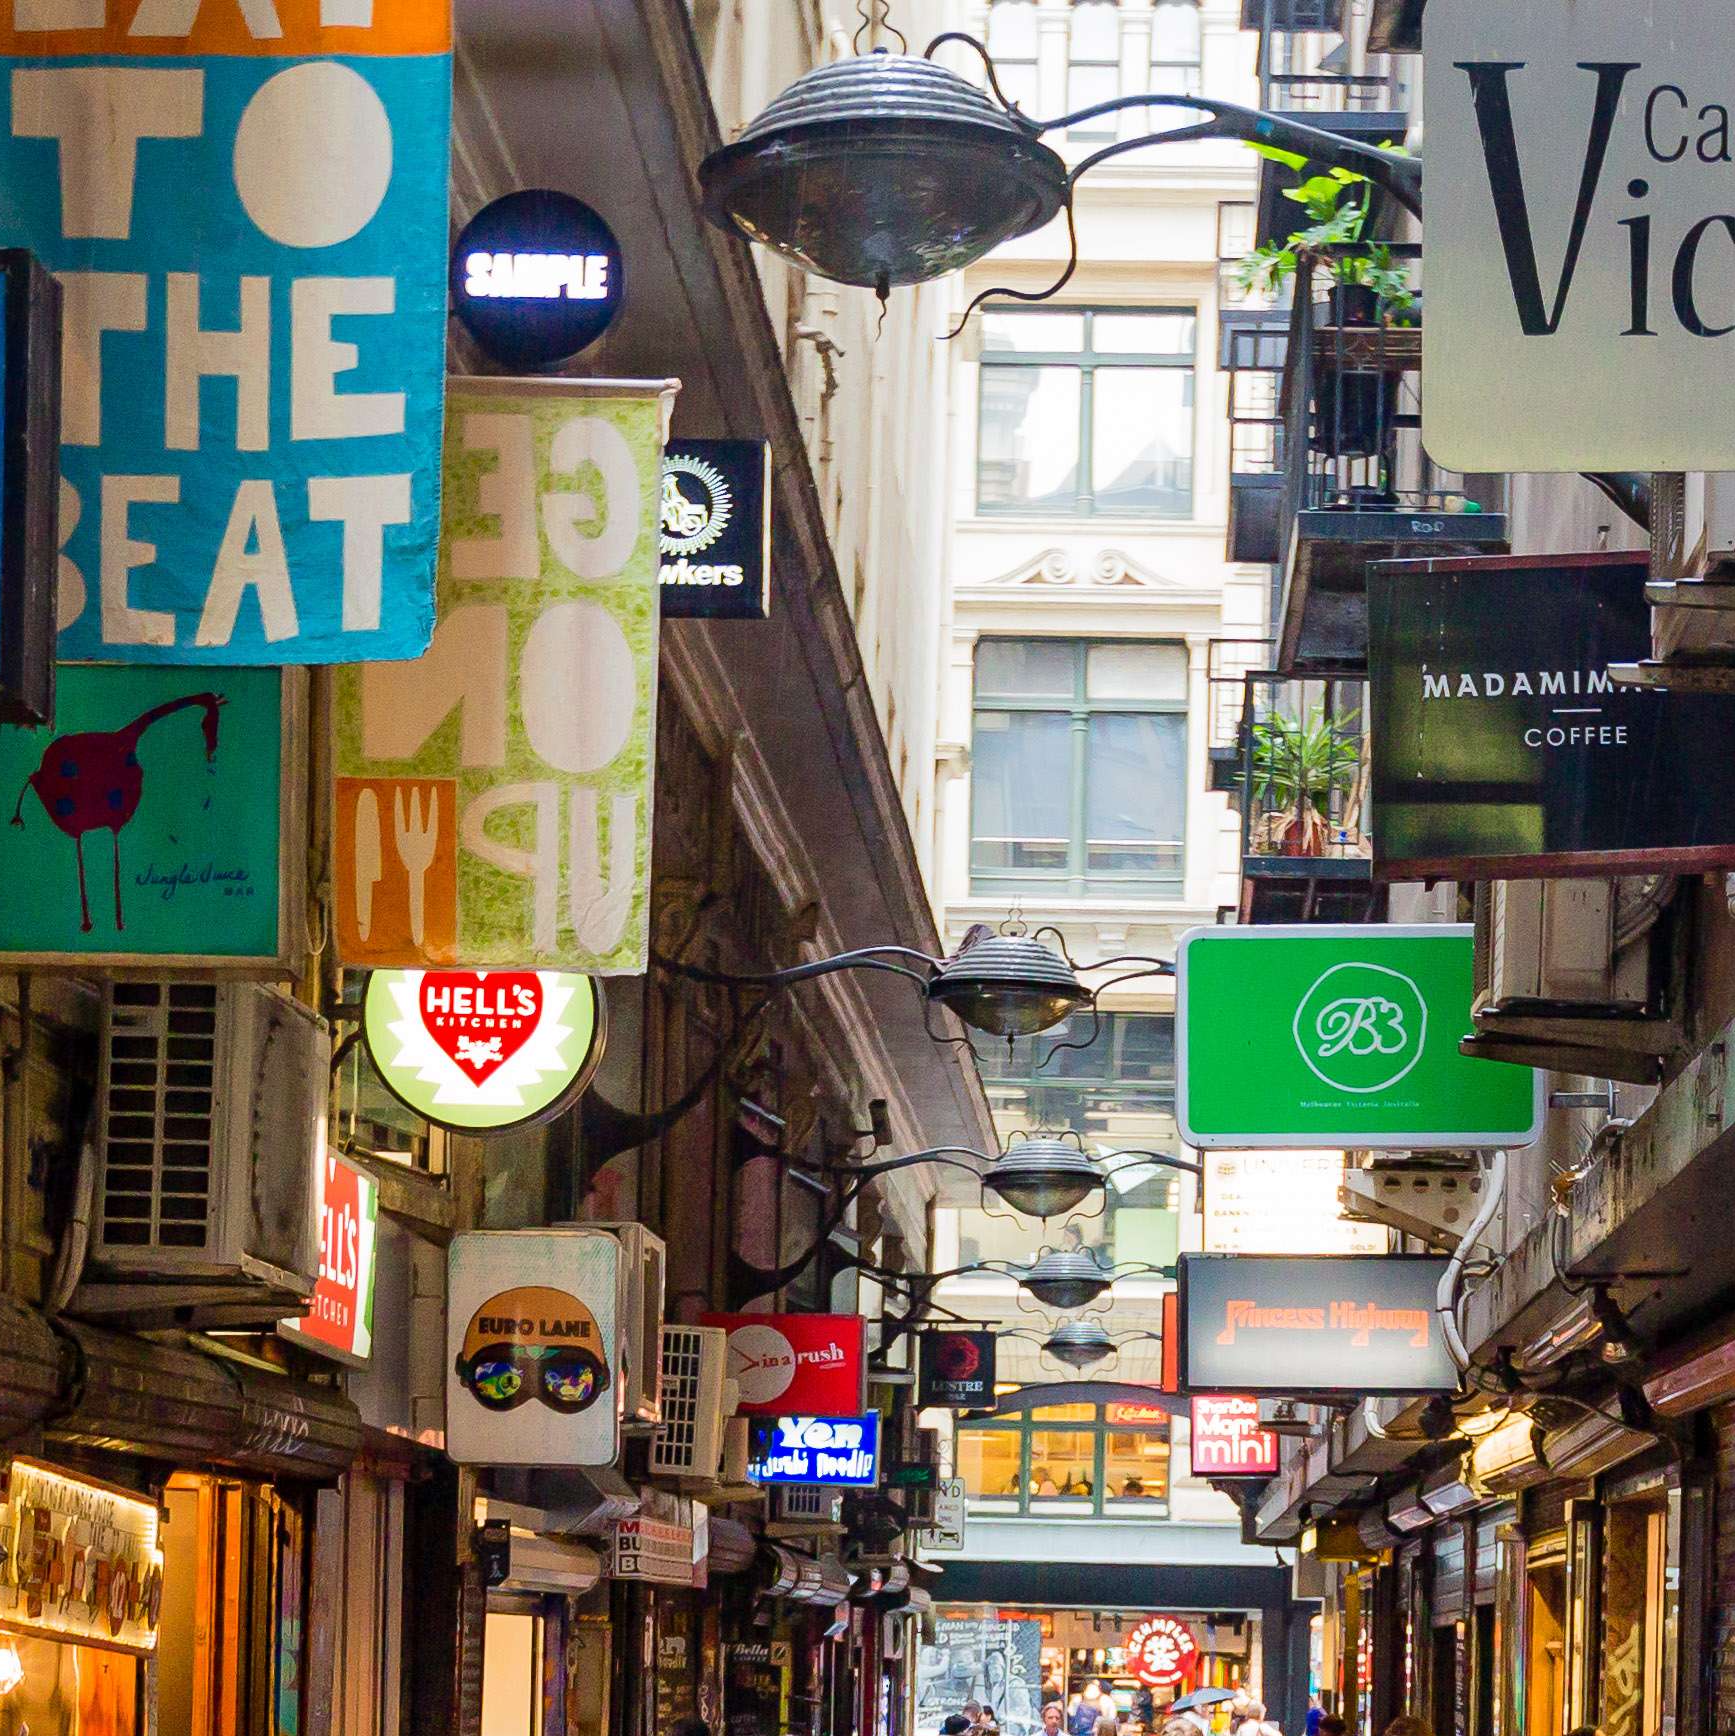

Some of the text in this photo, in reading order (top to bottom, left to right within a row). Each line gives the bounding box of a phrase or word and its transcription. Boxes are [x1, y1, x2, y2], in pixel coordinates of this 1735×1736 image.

[11, 61, 394, 249] TO
[465, 252, 610, 300] SAMPLE
[56, 272, 406, 452] THE
[658, 557, 744, 588] wkers
[1524, 726, 1628, 747] COFFEE
[426, 984, 537, 1016] HELL'S
[436, 1016, 523, 1030] KITCHEN
[478, 1316, 591, 1338] EURO LANE
[797, 1342, 845, 1365] rush
[778, 1416, 863, 1449] Yen
[1198, 1432, 1272, 1464] mini
[1128, 1618, 1195, 1655] CRUMPLER
